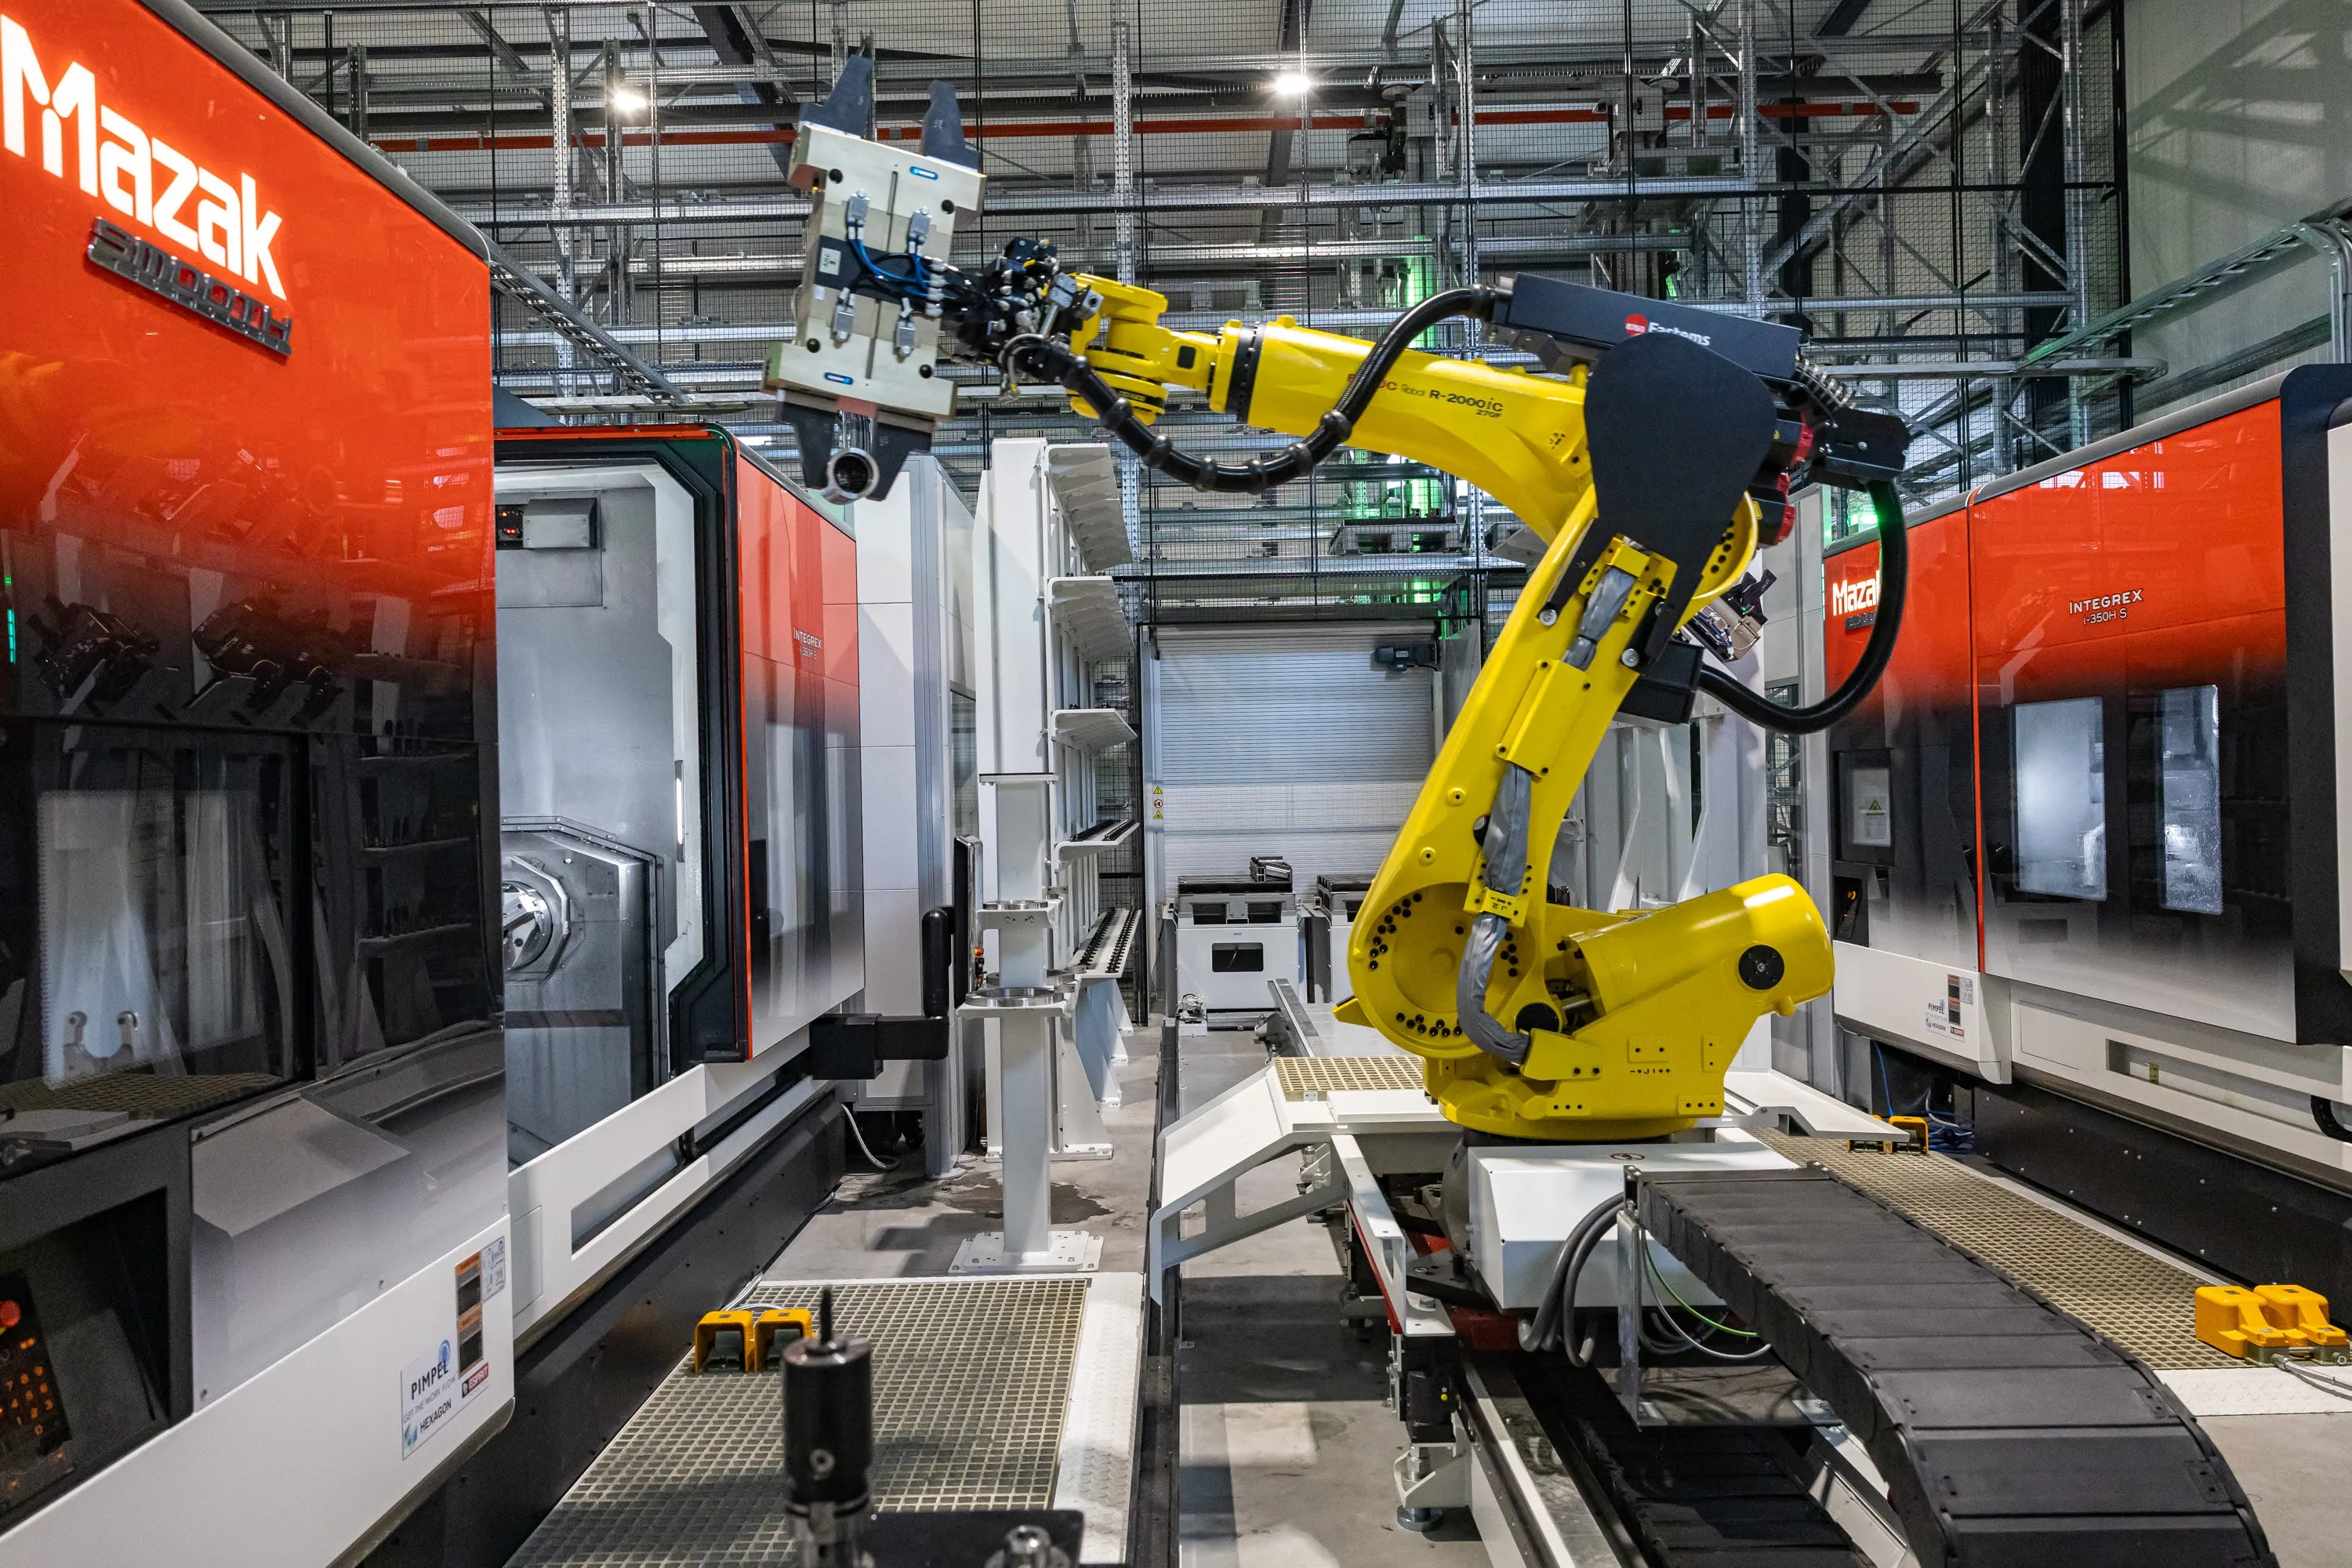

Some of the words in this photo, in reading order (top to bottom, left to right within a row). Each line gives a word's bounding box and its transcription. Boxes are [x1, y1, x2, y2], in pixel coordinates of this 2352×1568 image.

[1, 13, 288, 301] Mazak
[1429, 390, 1504, 412] R-2000iC
[1475, 408, 1503, 419] 270F
[2069, 588, 2143, 615] INTEGREX
[2083, 609, 2117, 625] i-350H
[2119, 608, 2127, 619] S
[793, 626, 822, 649] INTEGREX
[411, 1359, 449, 1400] PIMPEL
[414, 1400, 425, 1414] THE
[425, 1388, 441, 1405] WORK
[419, 1399, 452, 1434] HEXAGON
